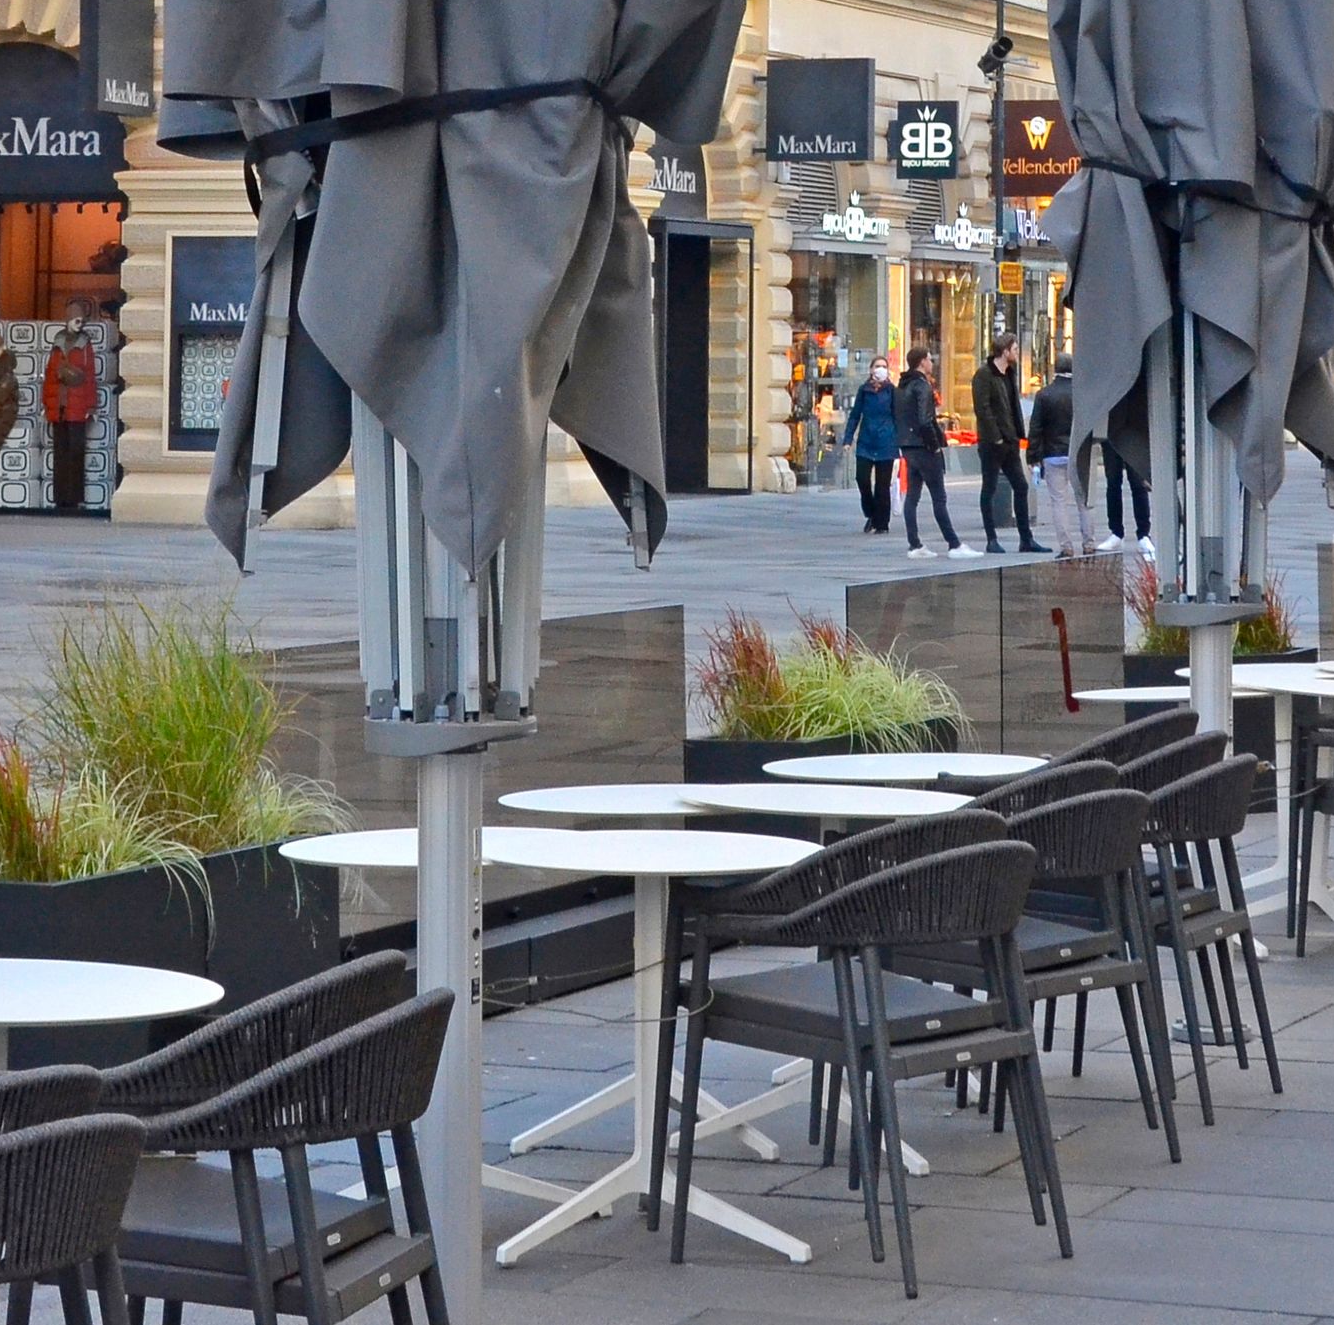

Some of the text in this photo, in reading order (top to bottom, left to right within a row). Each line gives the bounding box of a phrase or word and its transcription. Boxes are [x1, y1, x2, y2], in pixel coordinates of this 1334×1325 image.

[104, 78, 149, 107] MaxMara
[777, 134, 857, 154] MaxMara
[648, 156, 696, 193] xMara
[189, 302, 250, 322] MaxM
